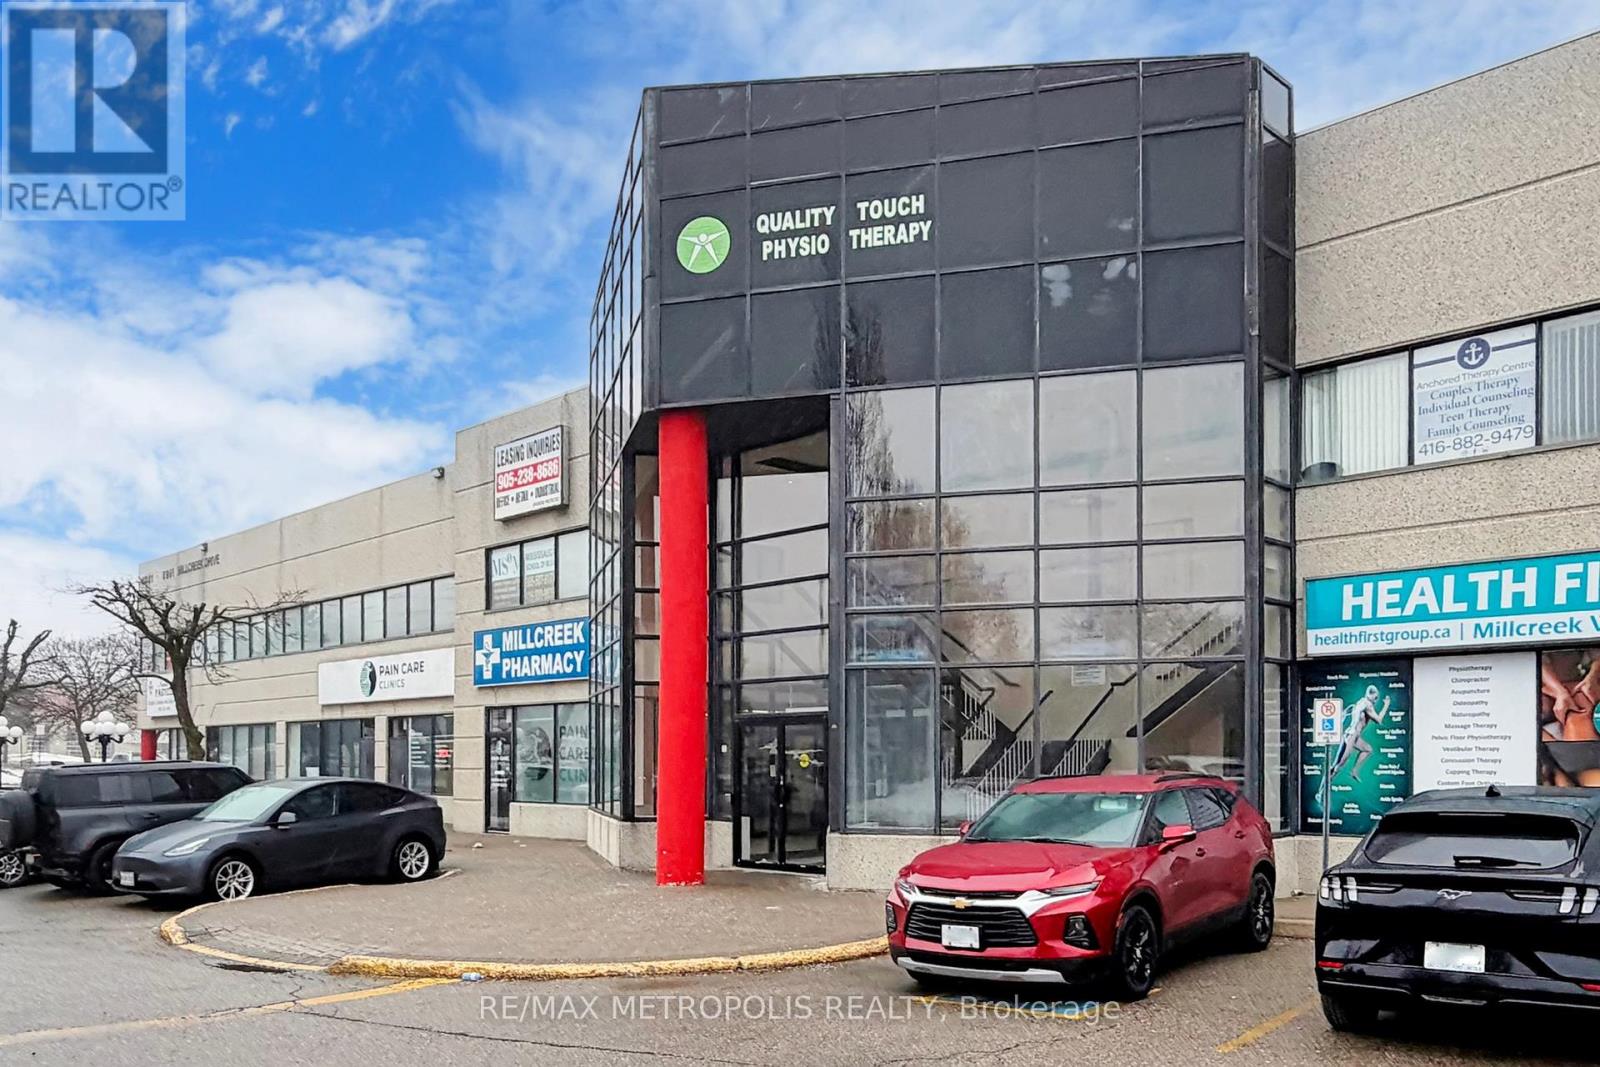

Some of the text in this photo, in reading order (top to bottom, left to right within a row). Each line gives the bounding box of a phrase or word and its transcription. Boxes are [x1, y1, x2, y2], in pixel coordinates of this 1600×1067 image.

[756, 194, 925, 234] QUALITY TOUCH
[762, 220, 932, 261] PHYSIO THERAPY
[1416, 360, 1535, 391] Anchored Therapy Centre
[1430, 376, 1520, 401] Couples Therapy
[1418, 386, 1535, 416] Individual Counseling
[1440, 403, 1512, 424] Teen Therapy
[1418, 424, 1534, 457] 416-882-9479
[1427, 413, 1526, 438] Family Counseling
[497, 433, 560, 468] LEASING INQUIRIES
[497, 459, 559, 490] 905-238-8686
[1341, 567, 1538, 621] HEALTH
[502, 621, 585, 651] MILLCREEK
[1314, 626, 1450, 646] healthfirstgroup.ca
[1473, 616, 1582, 639] Millcreek
[379, 661, 424, 676] PAIN CARE
[502, 650, 585, 679] PHARMACY
[379, 679, 405, 690] CLINICS
[559, 725, 589, 739] PAIN
[559, 746, 594, 760] CARE
[559, 768, 588, 783] CLIN
